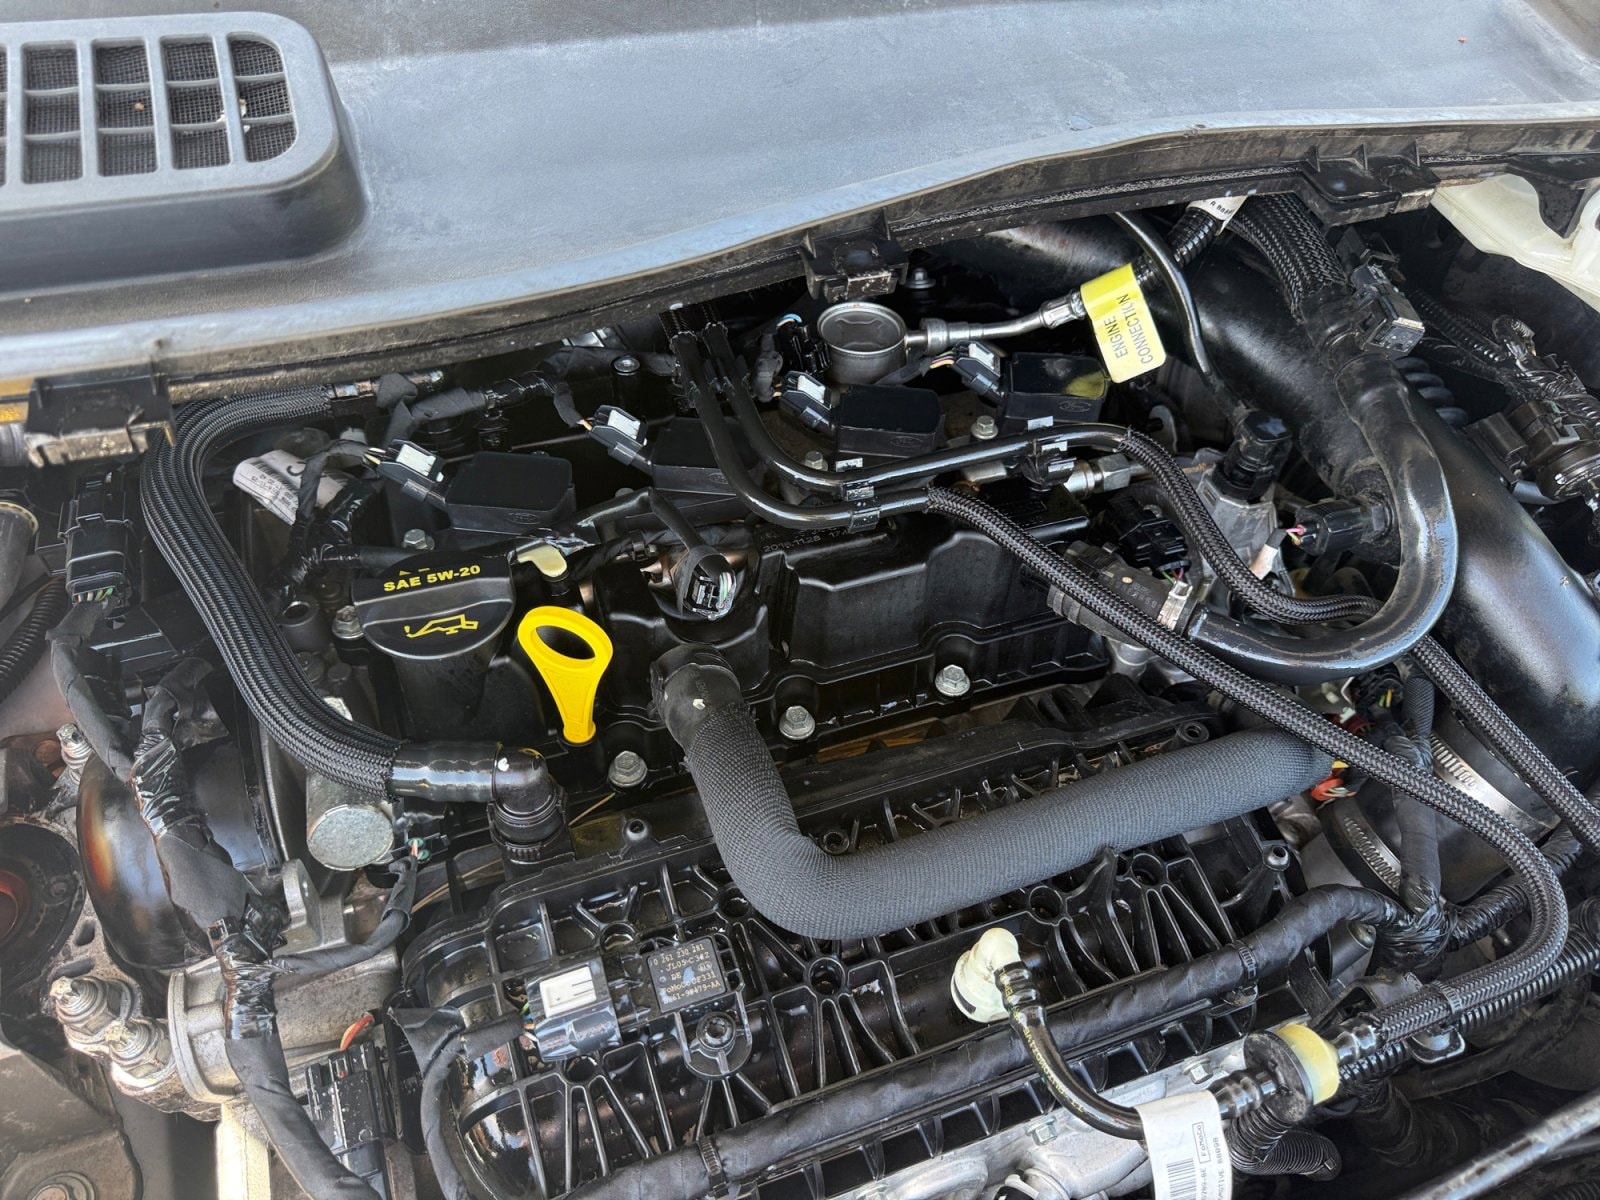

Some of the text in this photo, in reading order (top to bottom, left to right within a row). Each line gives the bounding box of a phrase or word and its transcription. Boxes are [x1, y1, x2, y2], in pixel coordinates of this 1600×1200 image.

[1104, 315, 1129, 359] ENGINE
[383, 565, 481, 592] SAE 5W-20
[1196, 1125, 1207, 1156] FoMoCo
